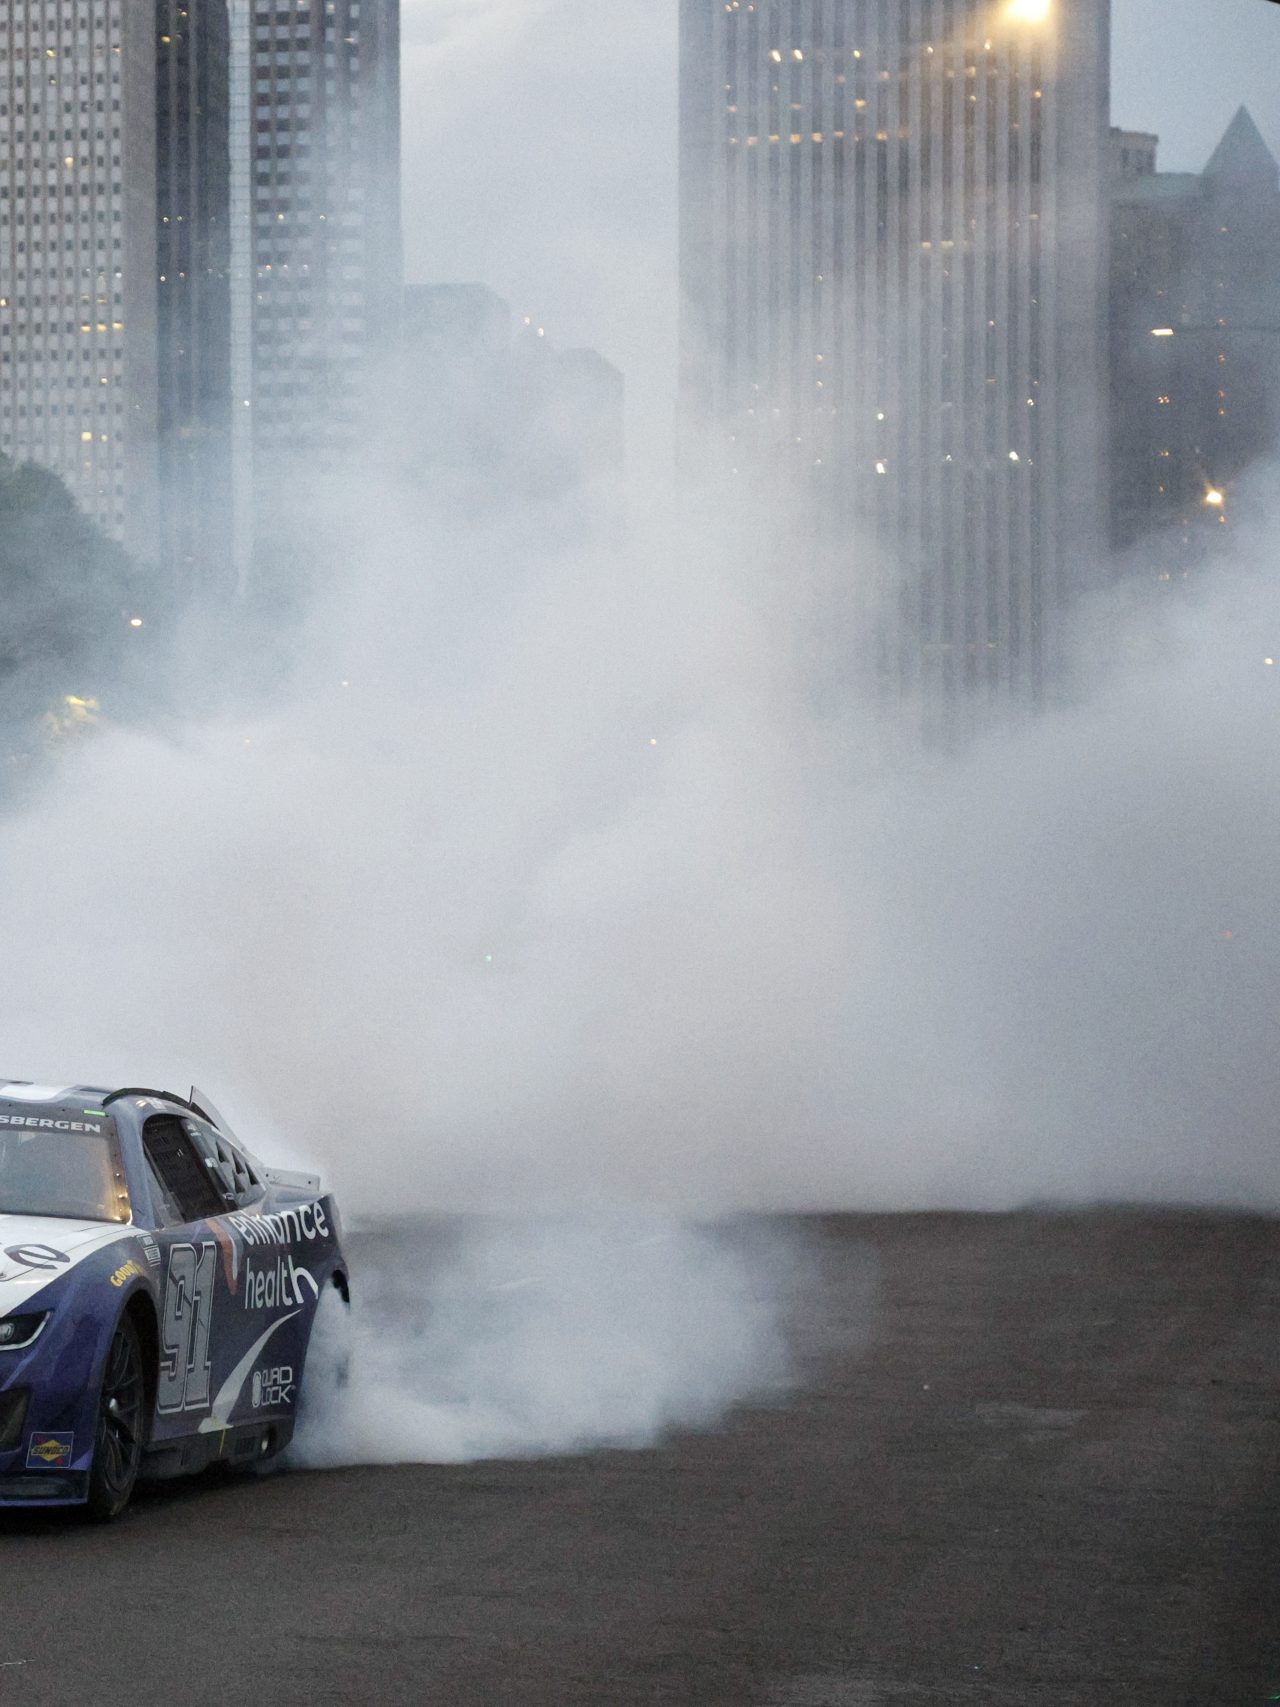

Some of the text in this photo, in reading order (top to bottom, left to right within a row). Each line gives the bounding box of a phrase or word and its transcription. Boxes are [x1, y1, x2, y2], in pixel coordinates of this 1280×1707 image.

[228, 1201, 329, 1247] enhance
[244, 1254, 319, 1310] health
[156, 1241, 217, 1415] 91
